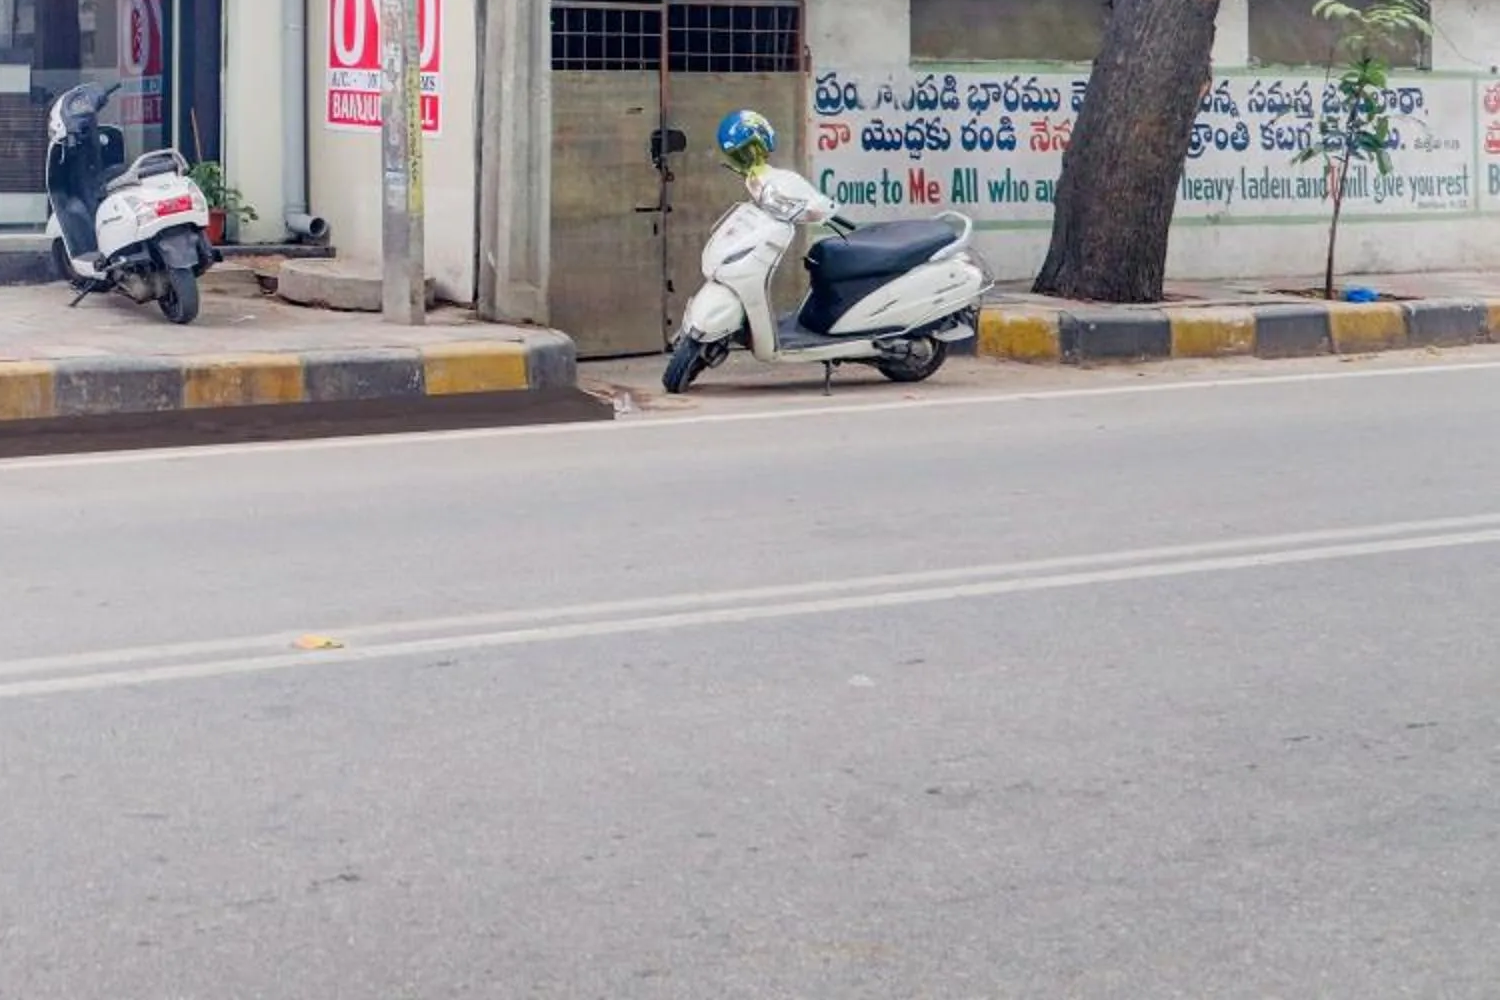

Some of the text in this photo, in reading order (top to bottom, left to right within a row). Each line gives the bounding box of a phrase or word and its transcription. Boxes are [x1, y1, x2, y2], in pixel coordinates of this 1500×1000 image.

[817, 122, 851, 151] నా
[961, 115, 1017, 152] రండి
[820, 168, 877, 206] Come
[881, 167, 903, 205] to
[908, 167, 942, 205] Me
[951, 167, 980, 204] All
[987, 167, 1030, 203] who
[1409, 174, 1434, 203] you
[1437, 162, 1471, 198] rest
